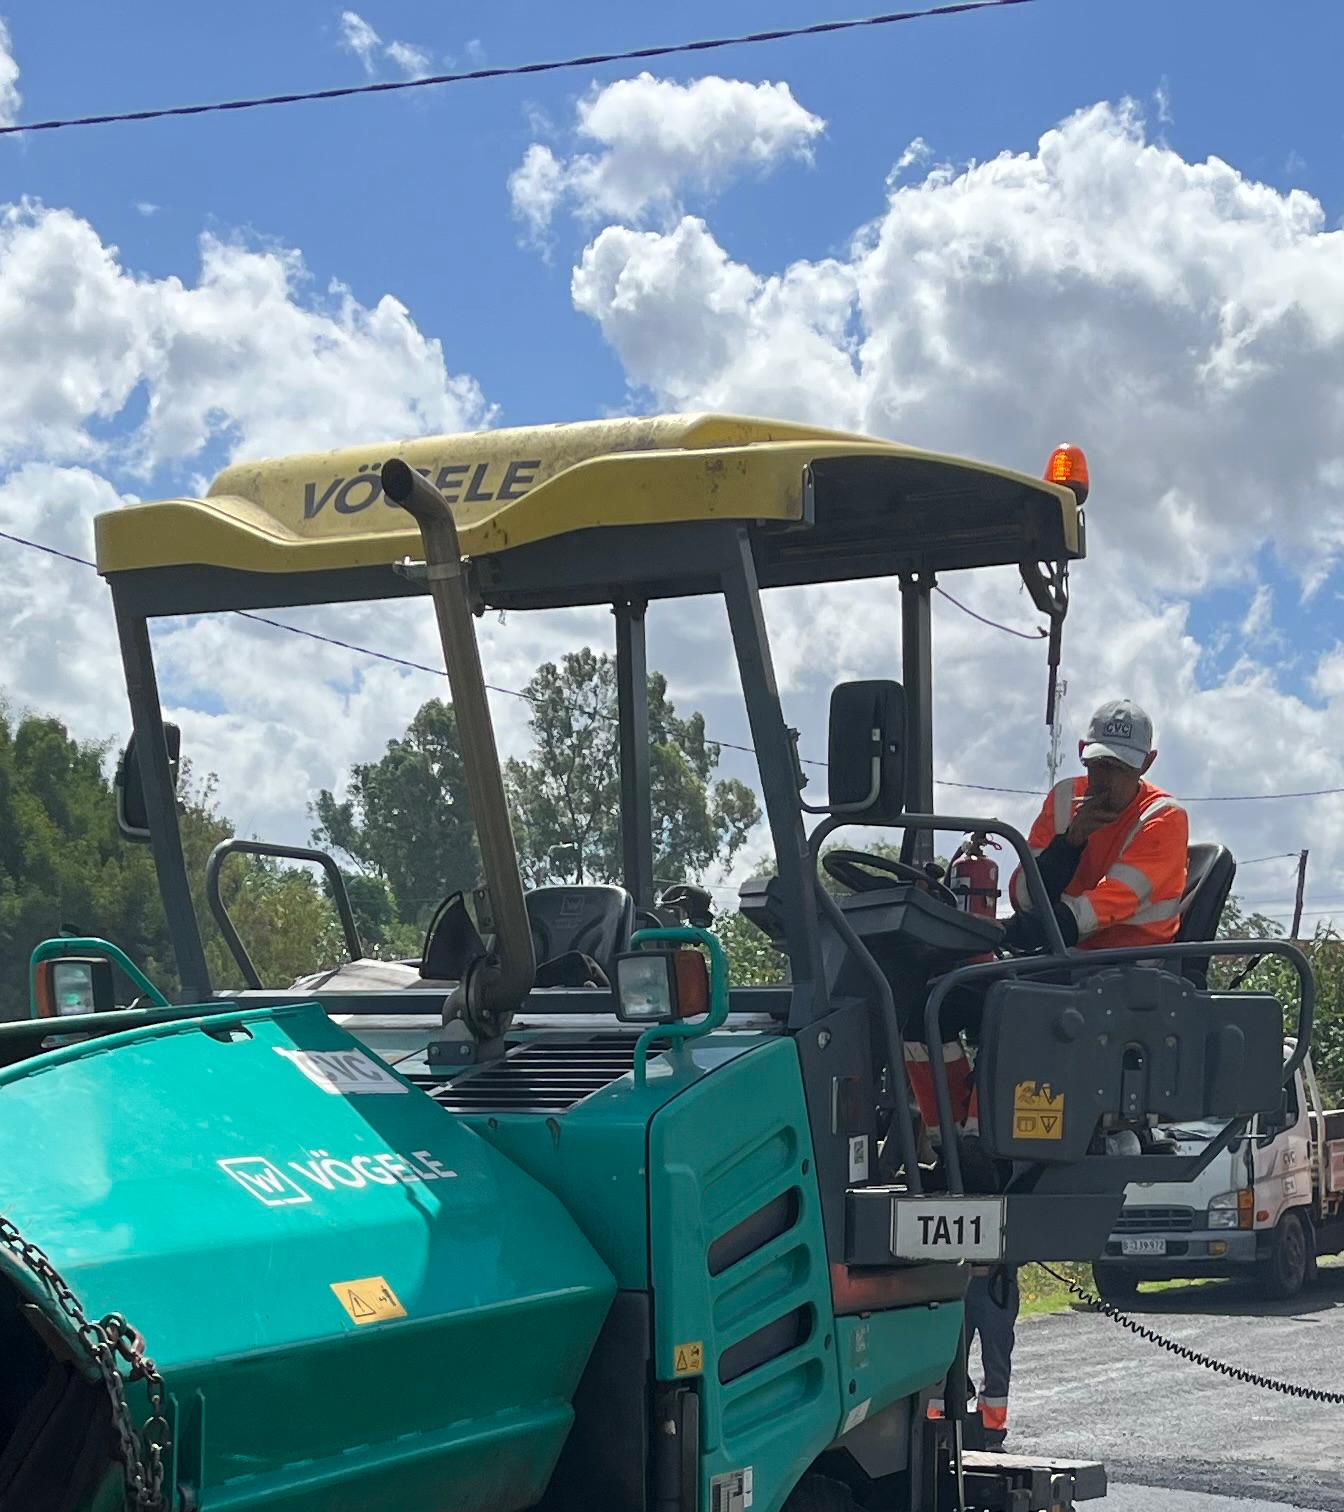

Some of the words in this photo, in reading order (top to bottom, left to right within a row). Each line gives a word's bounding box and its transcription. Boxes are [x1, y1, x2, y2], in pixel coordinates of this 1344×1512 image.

[303, 459, 541, 520] VÖELE
[288, 1149, 458, 1190] VÖGELE
[917, 1215, 981, 1246] TA11
